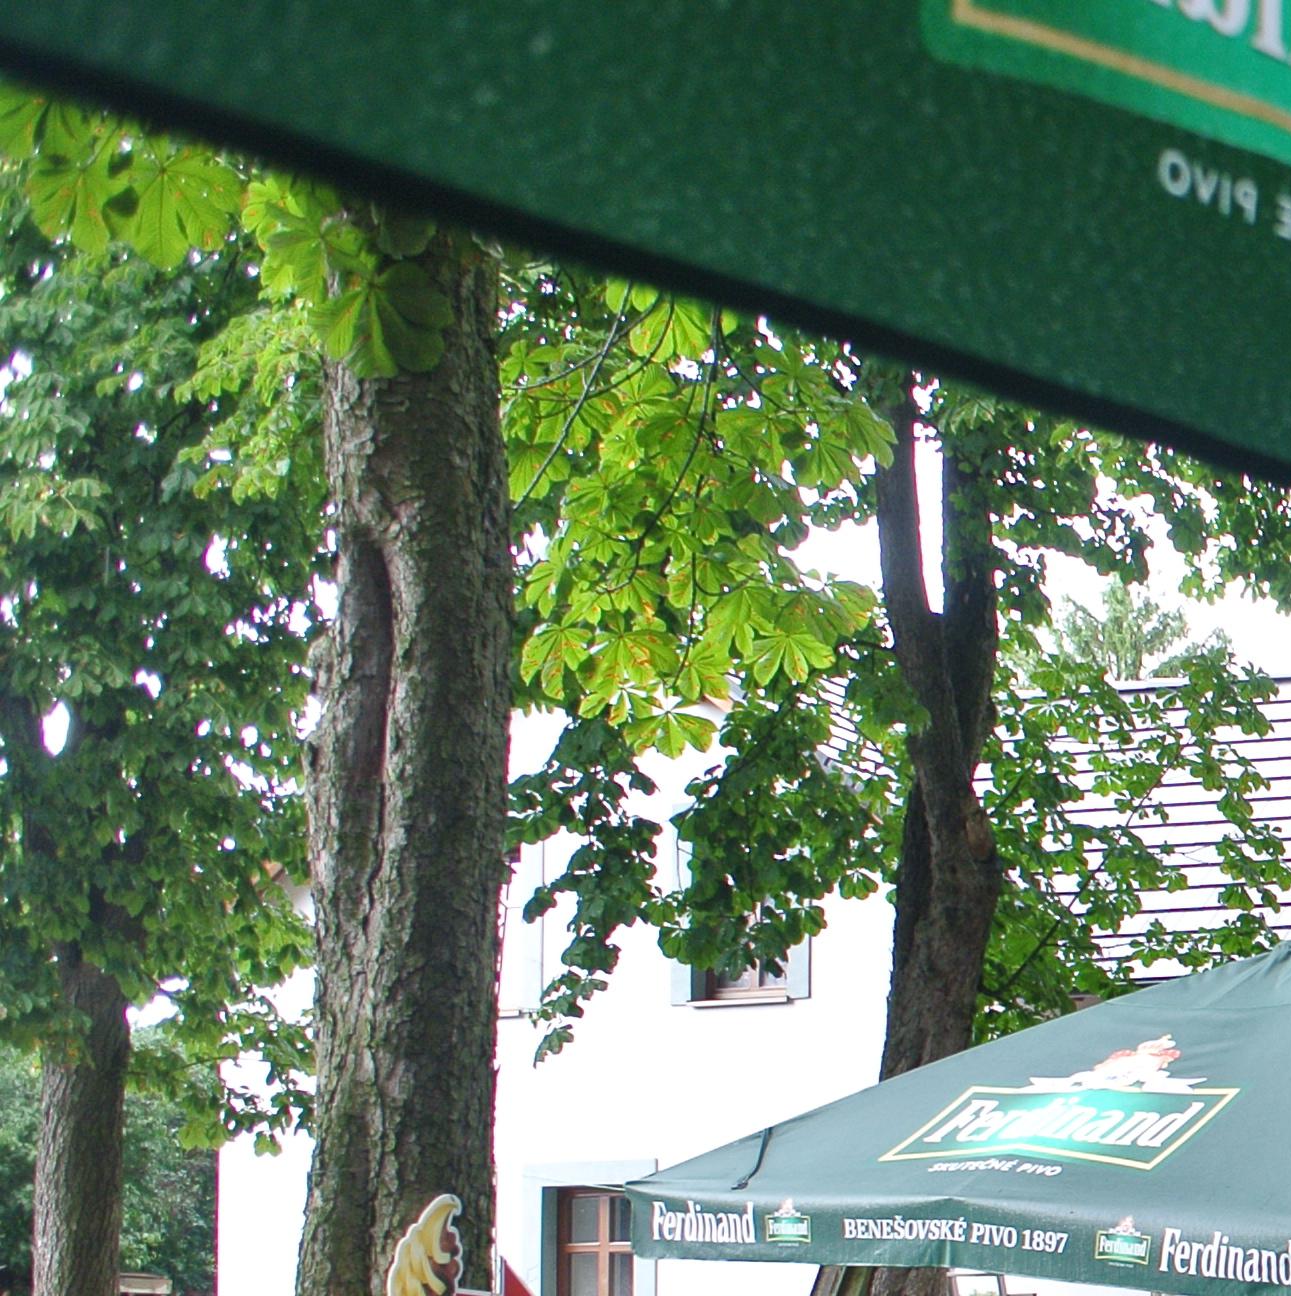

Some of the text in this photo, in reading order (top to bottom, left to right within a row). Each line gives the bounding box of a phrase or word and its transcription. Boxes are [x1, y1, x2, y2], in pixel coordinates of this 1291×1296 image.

[922, 1097, 1205, 1148] Ferdinand
[1016, 1162, 1063, 1177] PIVO
[652, 1200, 756, 1243] Ferdinand
[843, 1215, 1069, 1254] BENEŠOVSKÉ PIVO 1897
